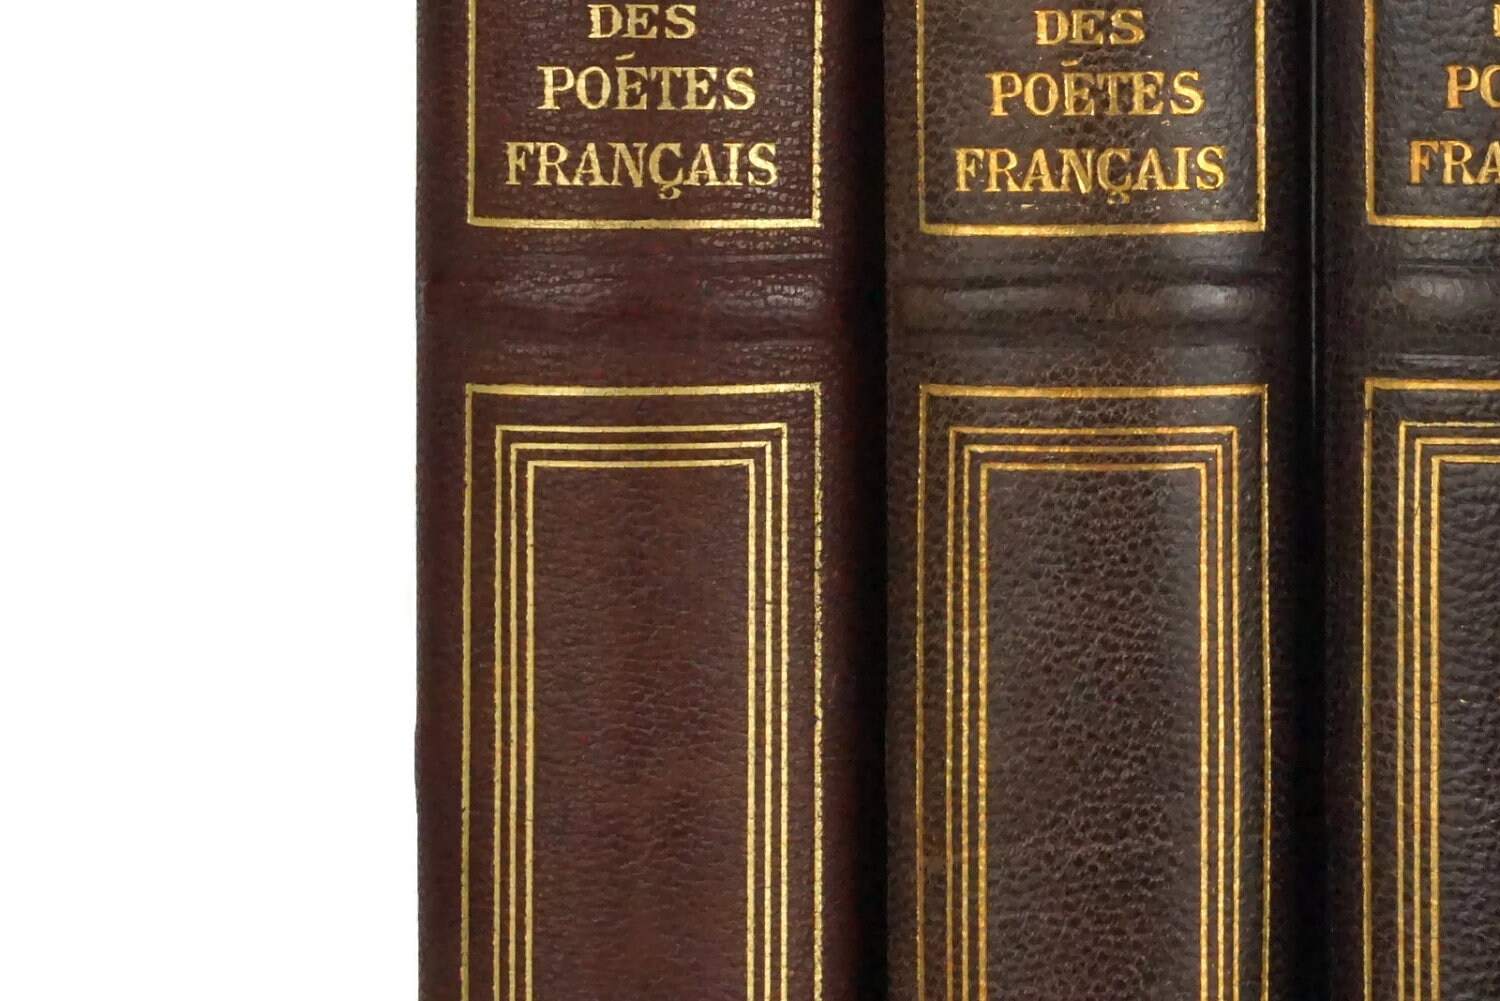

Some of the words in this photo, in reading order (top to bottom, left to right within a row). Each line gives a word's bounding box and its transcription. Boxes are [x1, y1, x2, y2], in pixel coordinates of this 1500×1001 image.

[587, 3, 696, 39] DES
[1034, 9, 1145, 45] DES
[537, 51, 757, 111] POÉTES
[985, 59, 1203, 117] POÉTES
[504, 141, 778, 199] FRANÇAIS
[954, 145, 1227, 204] FRANÇAIS
